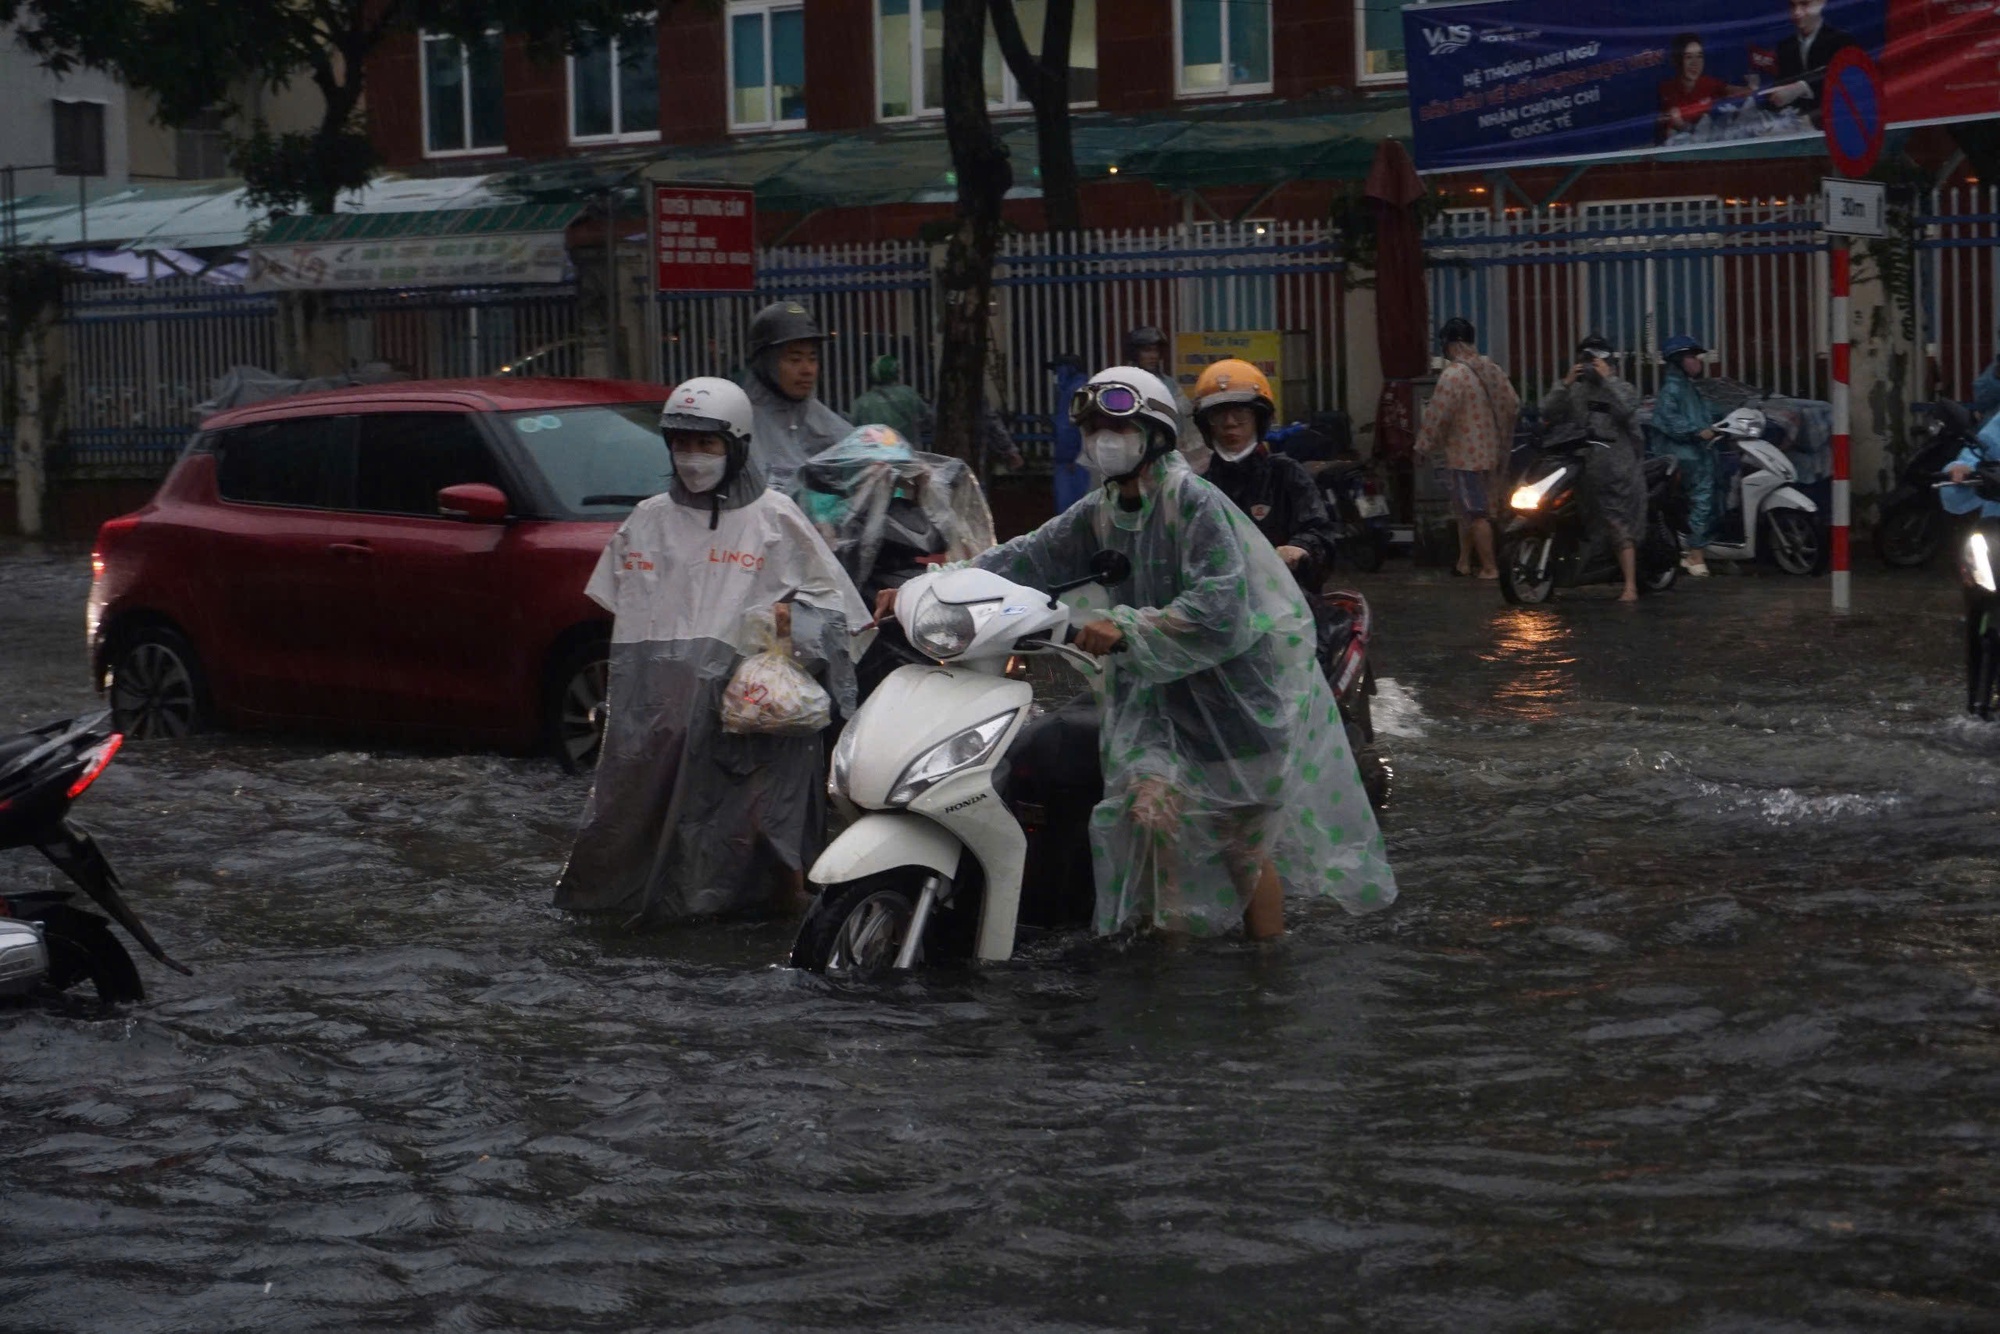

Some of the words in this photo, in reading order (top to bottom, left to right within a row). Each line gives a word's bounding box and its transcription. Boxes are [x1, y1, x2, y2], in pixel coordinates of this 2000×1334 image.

[1463, 69, 1482, 88] HỆ
[1484, 59, 1533, 81] THỐNG
[1534, 51, 1566, 71] ANH
[1566, 40, 1601, 62] NGỮ
[1478, 107, 1519, 129] NHẬN
[1519, 95, 1573, 118] CHỨNG
[1510, 117, 1554, 139] QUỐC
[1553, 110, 1573, 129] TẾ
[1841, 197, 1865, 218] 30m
[945, 793, 988, 813] HONDA
